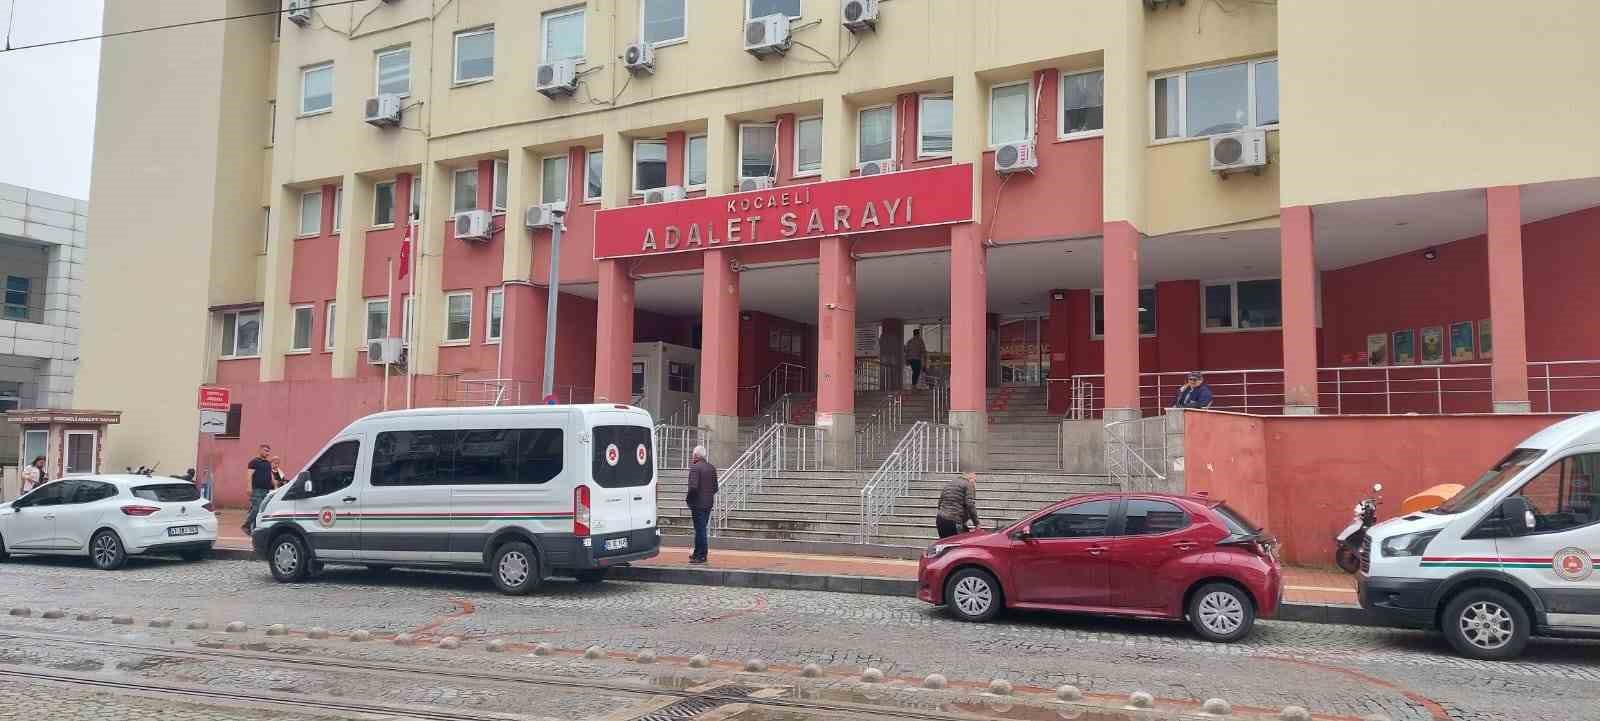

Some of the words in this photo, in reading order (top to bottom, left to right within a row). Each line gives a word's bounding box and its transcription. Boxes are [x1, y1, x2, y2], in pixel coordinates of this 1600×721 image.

[727, 187, 810, 213] KOCAELİ
[642, 216, 761, 251] ADALET
[780, 196, 913, 236] SARAYI
